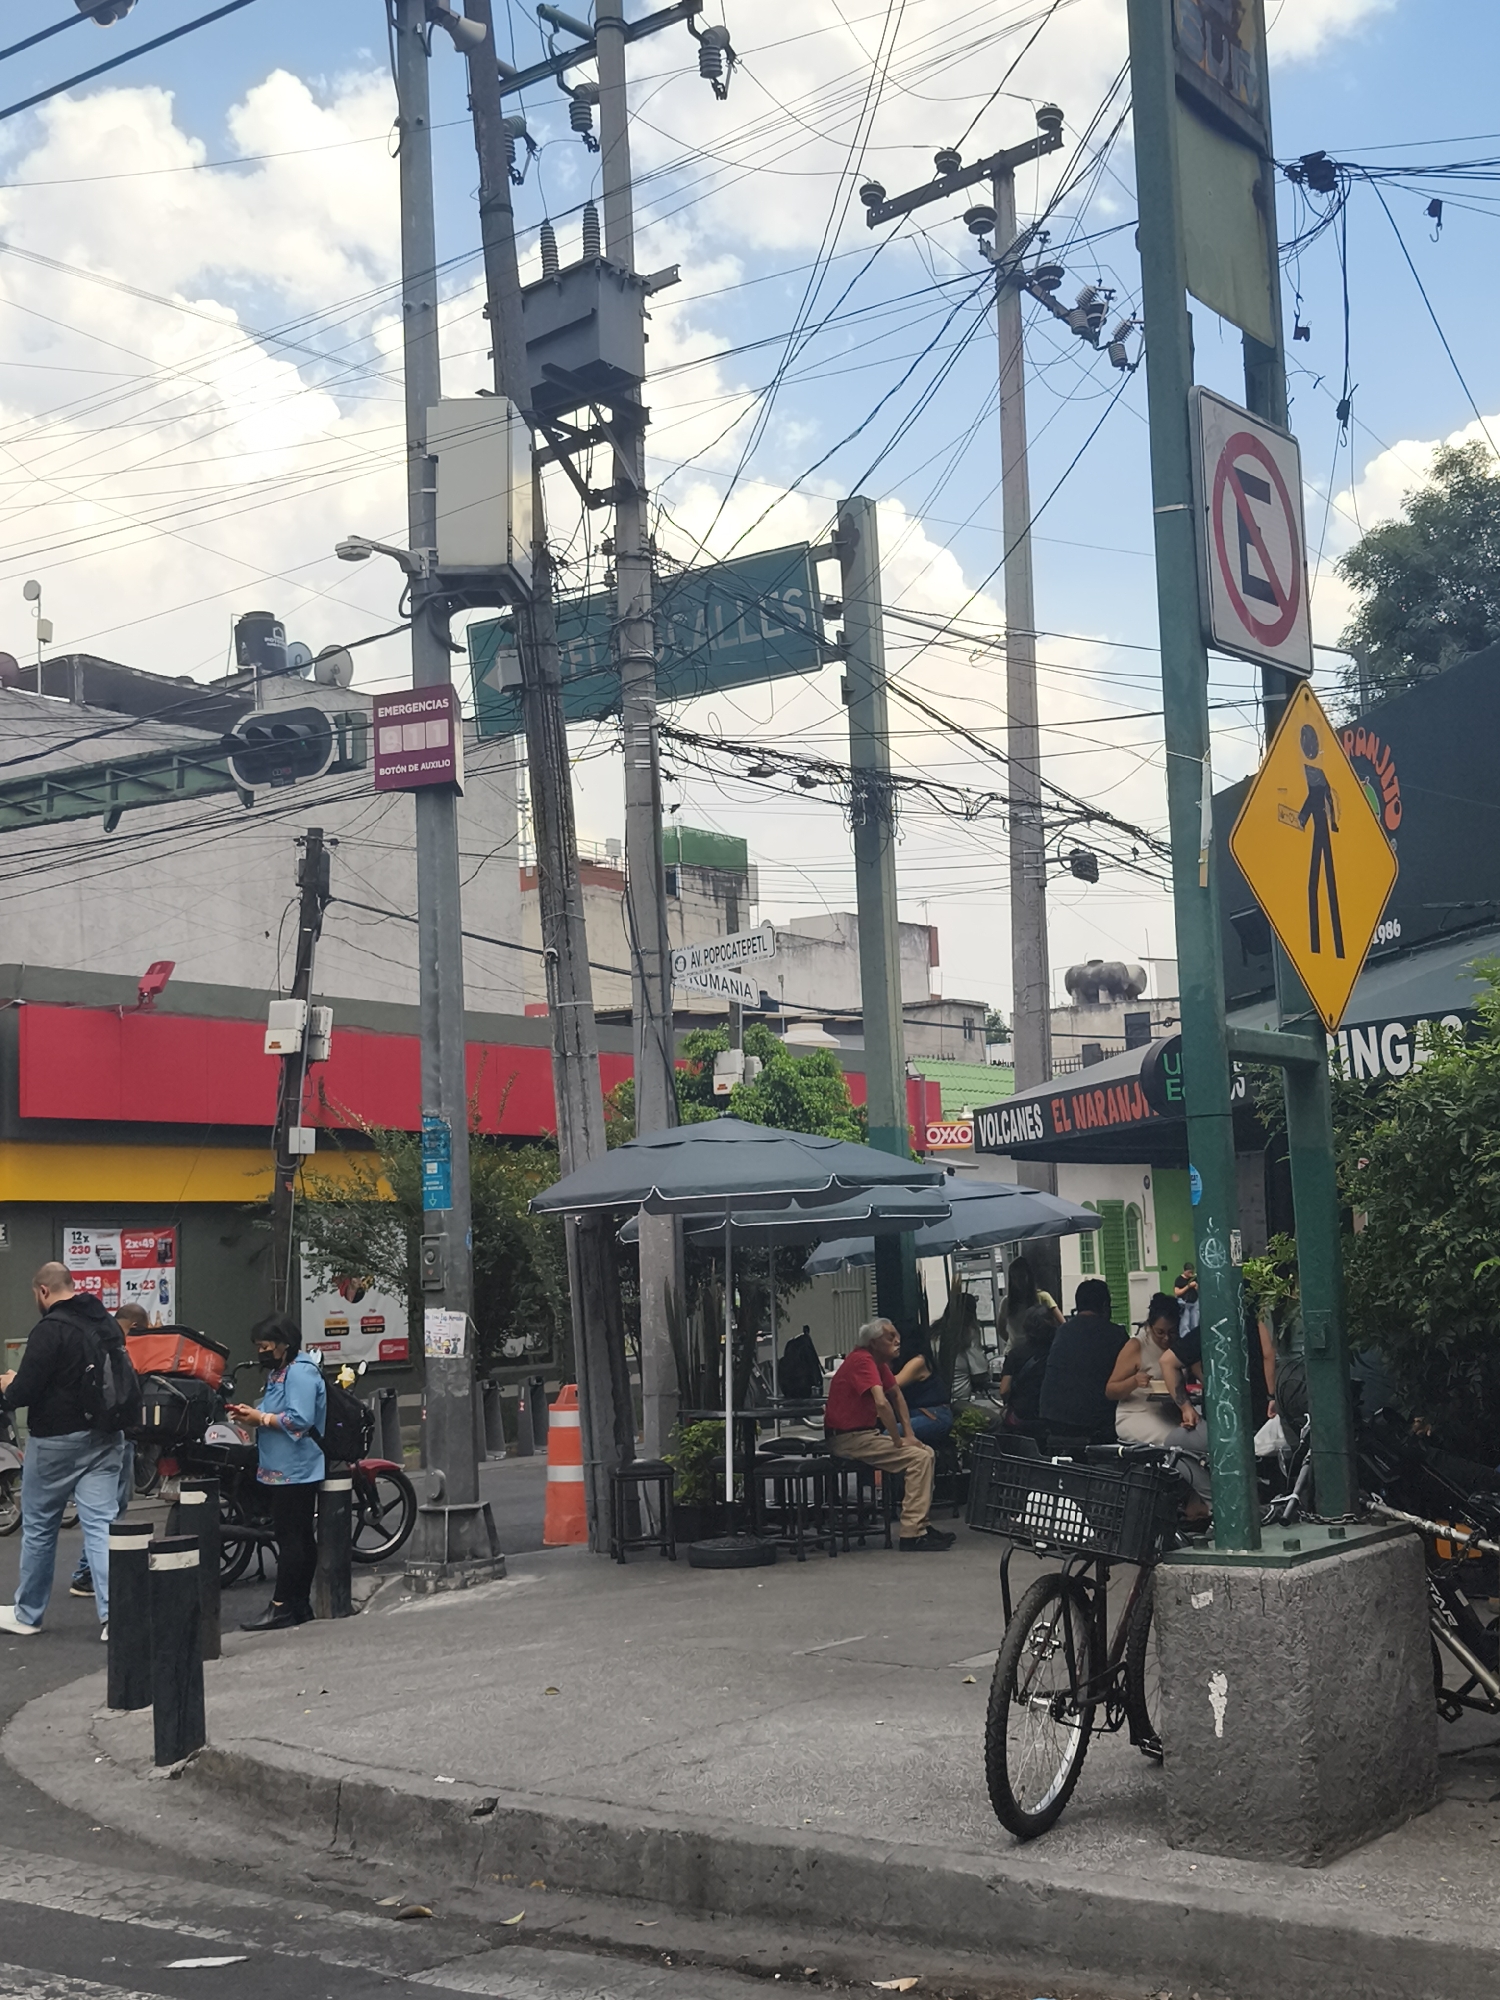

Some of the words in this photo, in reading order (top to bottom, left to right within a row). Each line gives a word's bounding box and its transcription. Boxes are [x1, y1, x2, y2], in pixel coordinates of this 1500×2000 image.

[378, 698, 449, 717] EMERGENCIAS
[379, 765, 407, 776] BOTÓN
[408, 763, 419, 772] DE
[420, 758, 451, 770] AUXILIO
[690, 950, 703, 969] AV.
[703, 934, 768, 967] POPOCATEPETL
[978, 1102, 1043, 1147] VOLCANES
[1051, 1097, 1072, 1133] EL
[926, 1125, 973, 1147] OXXO
[71, 1231, 82, 1241] 12
[126, 1281, 138, 1291] 1x
